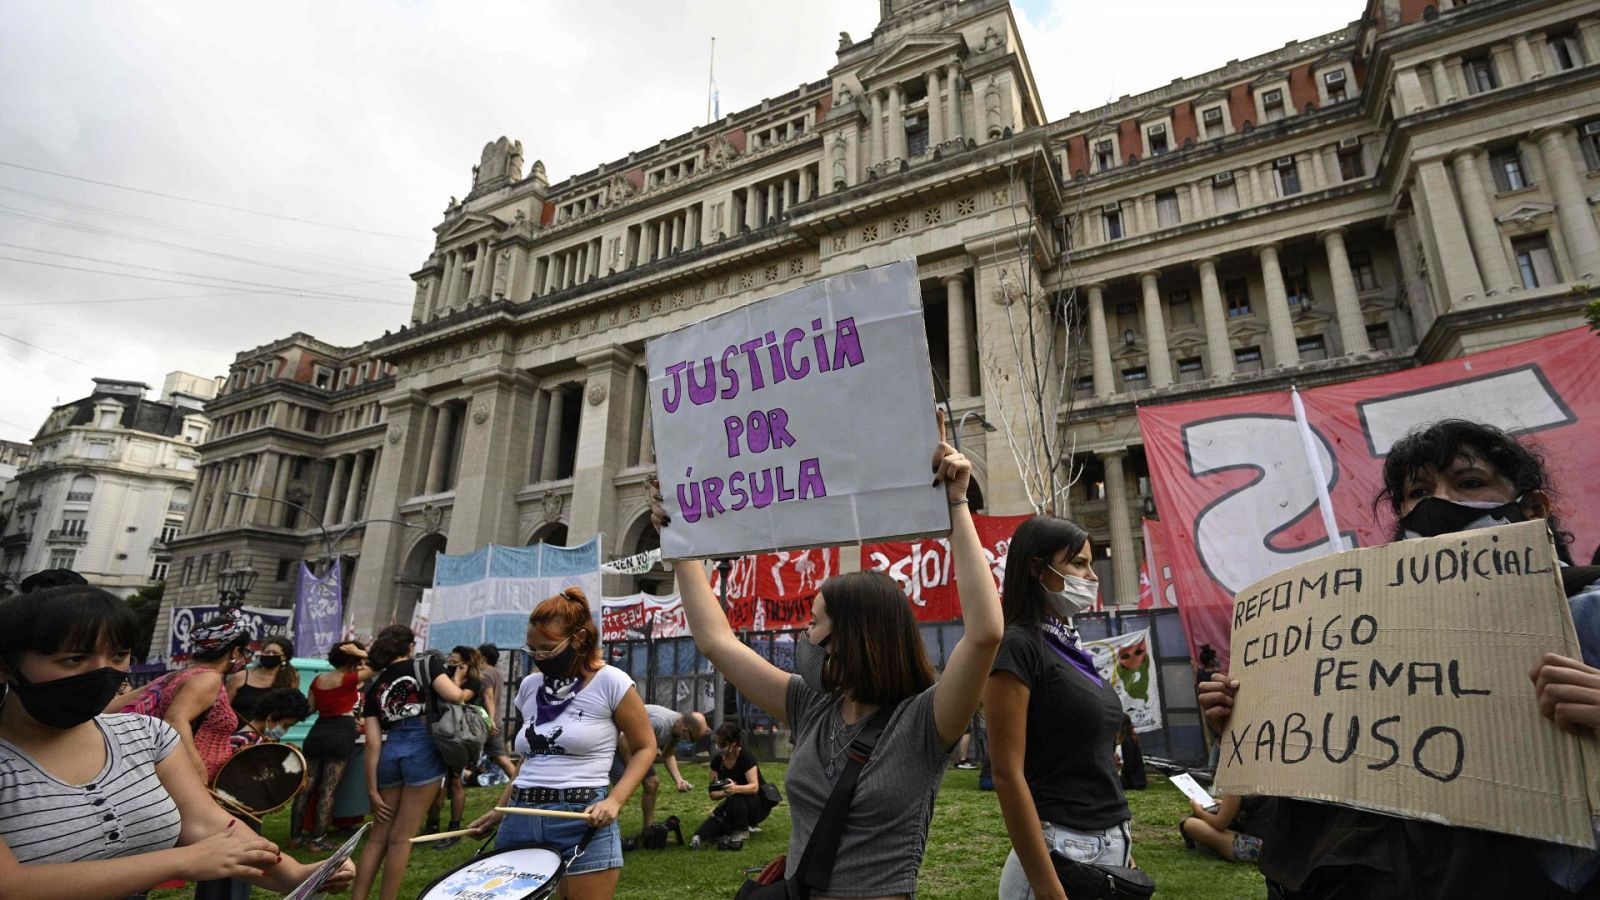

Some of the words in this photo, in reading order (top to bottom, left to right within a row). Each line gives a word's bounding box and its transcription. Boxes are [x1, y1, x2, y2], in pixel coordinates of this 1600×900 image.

[662, 316, 865, 414] JUSTICIA
[724, 407, 797, 458] POR
[677, 457, 827, 523] ÚRSULA
[1234, 567, 1363, 630] REFOMA
[1387, 536, 1552, 588] JUDICIAL
[1244, 614, 1378, 667] CODIGO
[1314, 656, 1491, 698] PENAL
